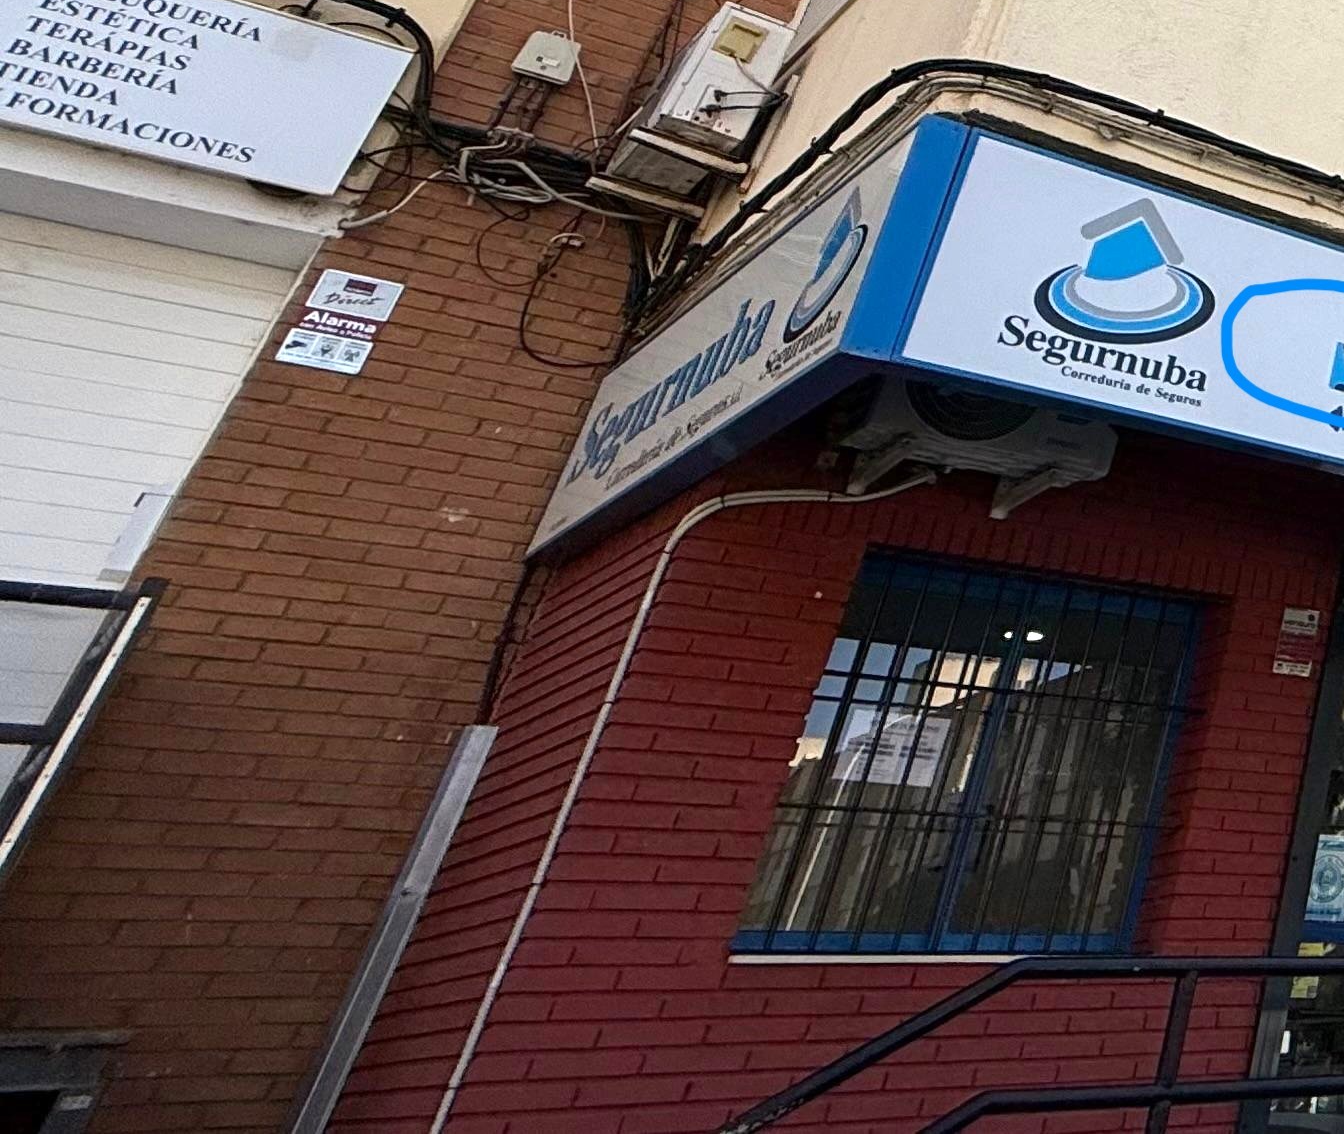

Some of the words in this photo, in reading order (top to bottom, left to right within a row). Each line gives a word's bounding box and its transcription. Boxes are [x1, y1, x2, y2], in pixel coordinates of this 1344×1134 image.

[0, 60, 118, 106] TIENDA
[6, 38, 177, 95] BARBERÍA
[6, 91, 256, 164] FORMACIONES
[303, 310, 377, 334] Alarma
[997, 314, 1208, 393] Segurnuba
[565, 298, 775, 488] Segurnuba
[1136, 383, 1151, 396] de
[1154, 386, 1201, 407] Seguros
